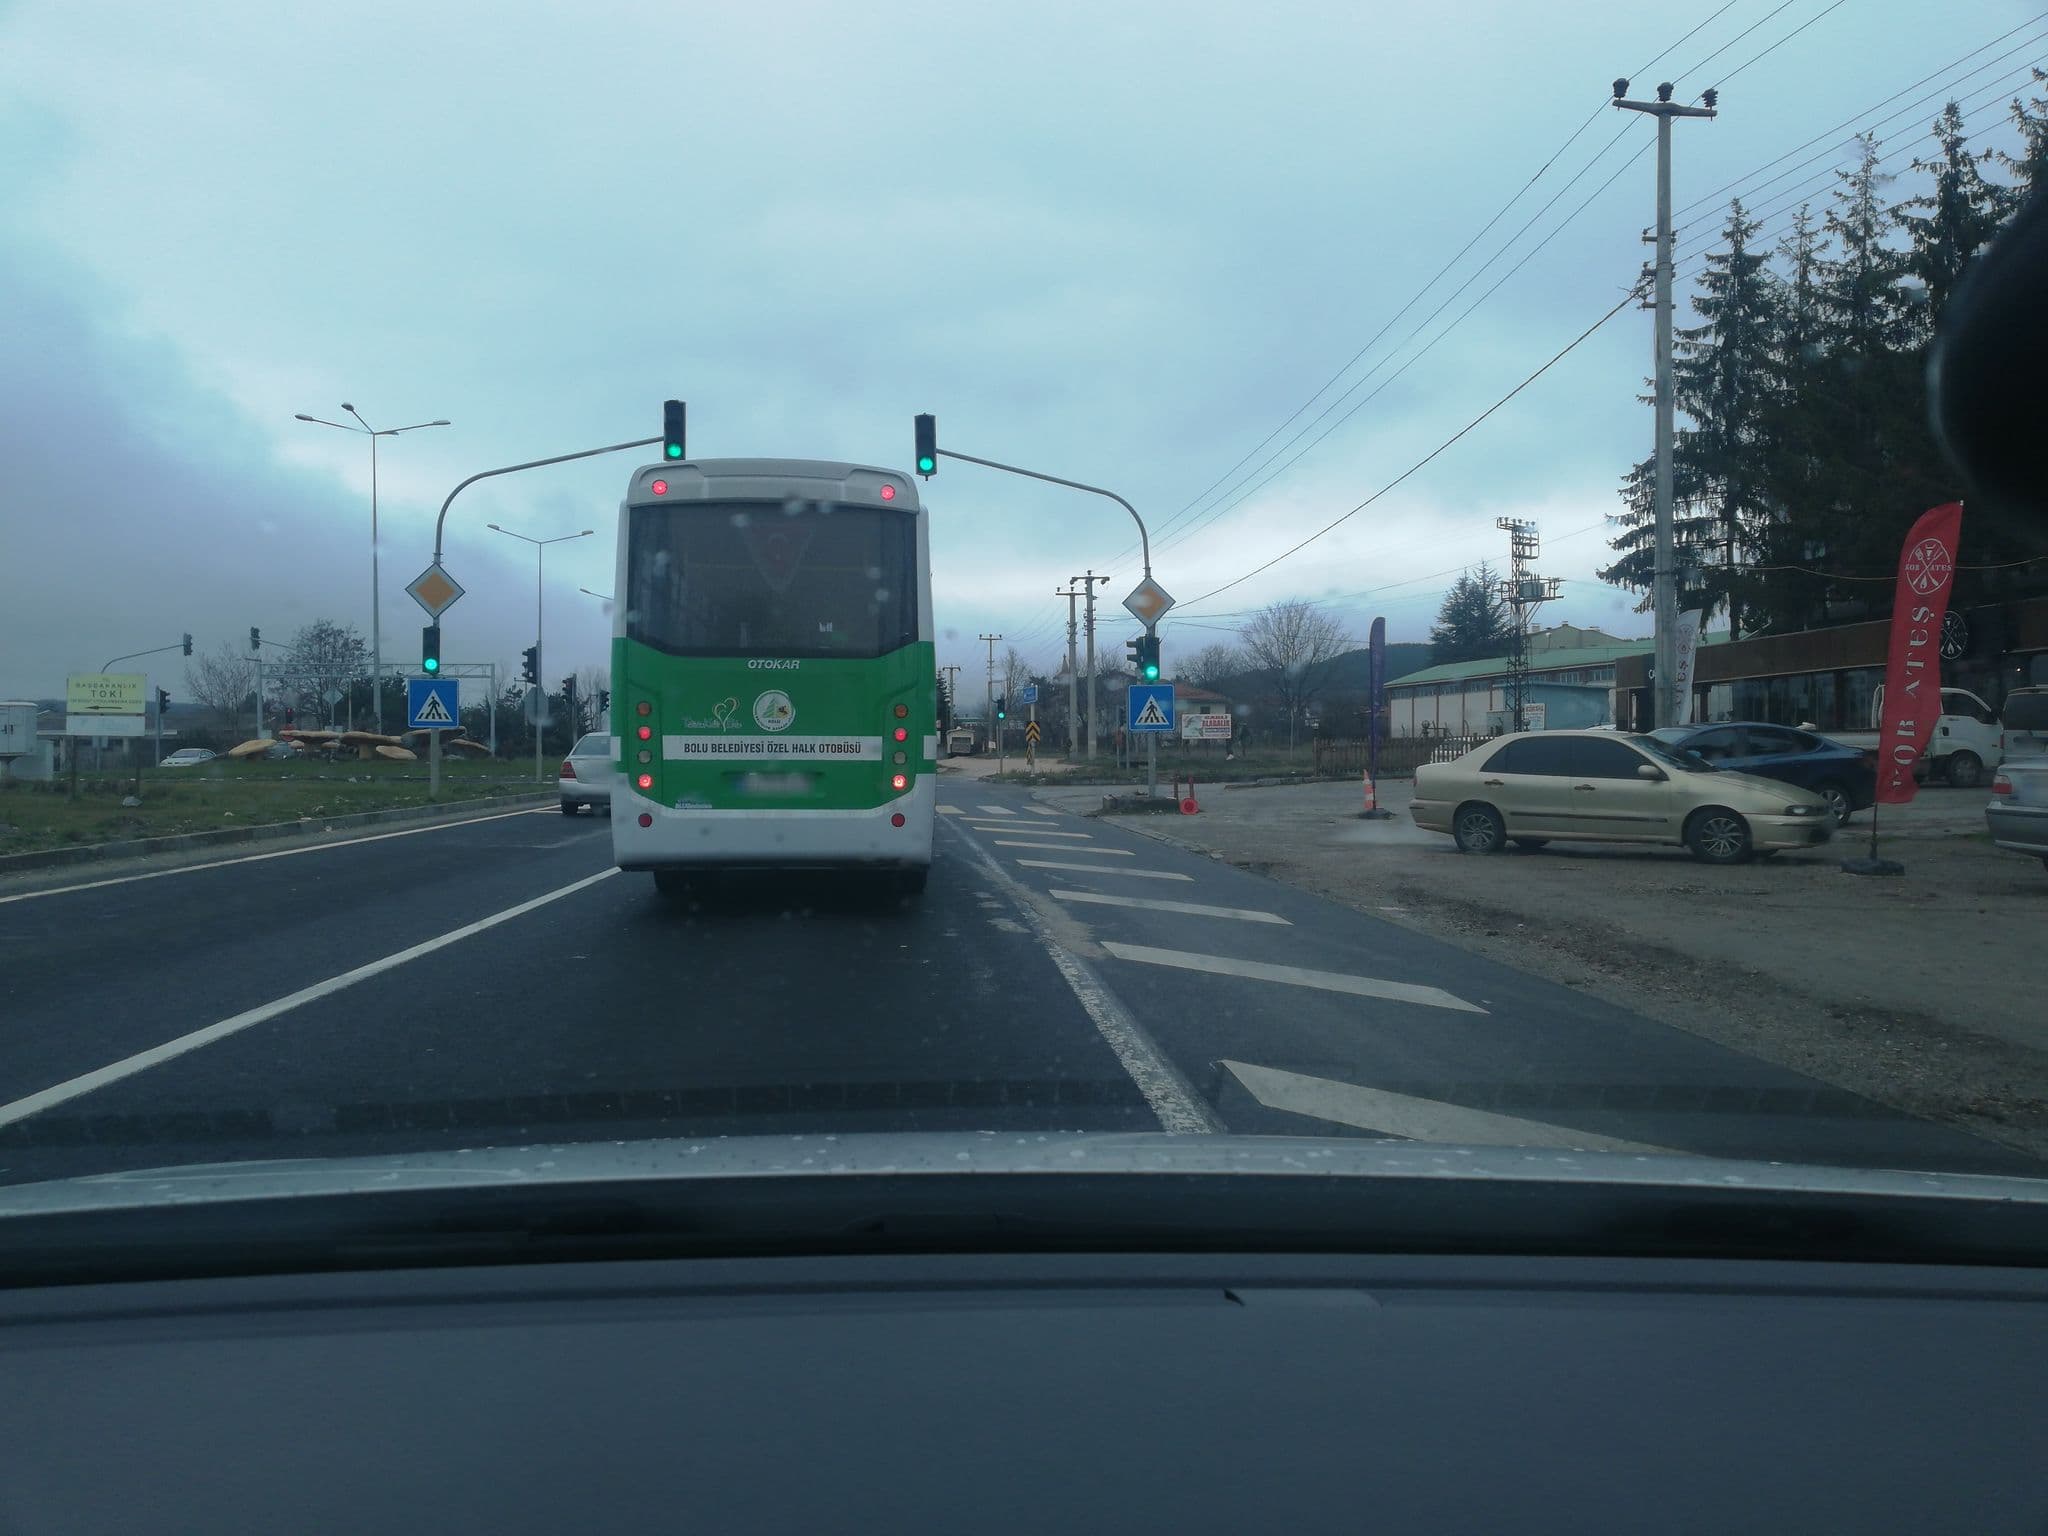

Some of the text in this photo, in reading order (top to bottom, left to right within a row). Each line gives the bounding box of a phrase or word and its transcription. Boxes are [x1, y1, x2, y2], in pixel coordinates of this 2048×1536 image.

[747, 659, 801, 669] OTOKAR
[684, 740, 862, 753] BOLU BELEDİYESİ ÖZEL HALK OTOBÜSÜ
